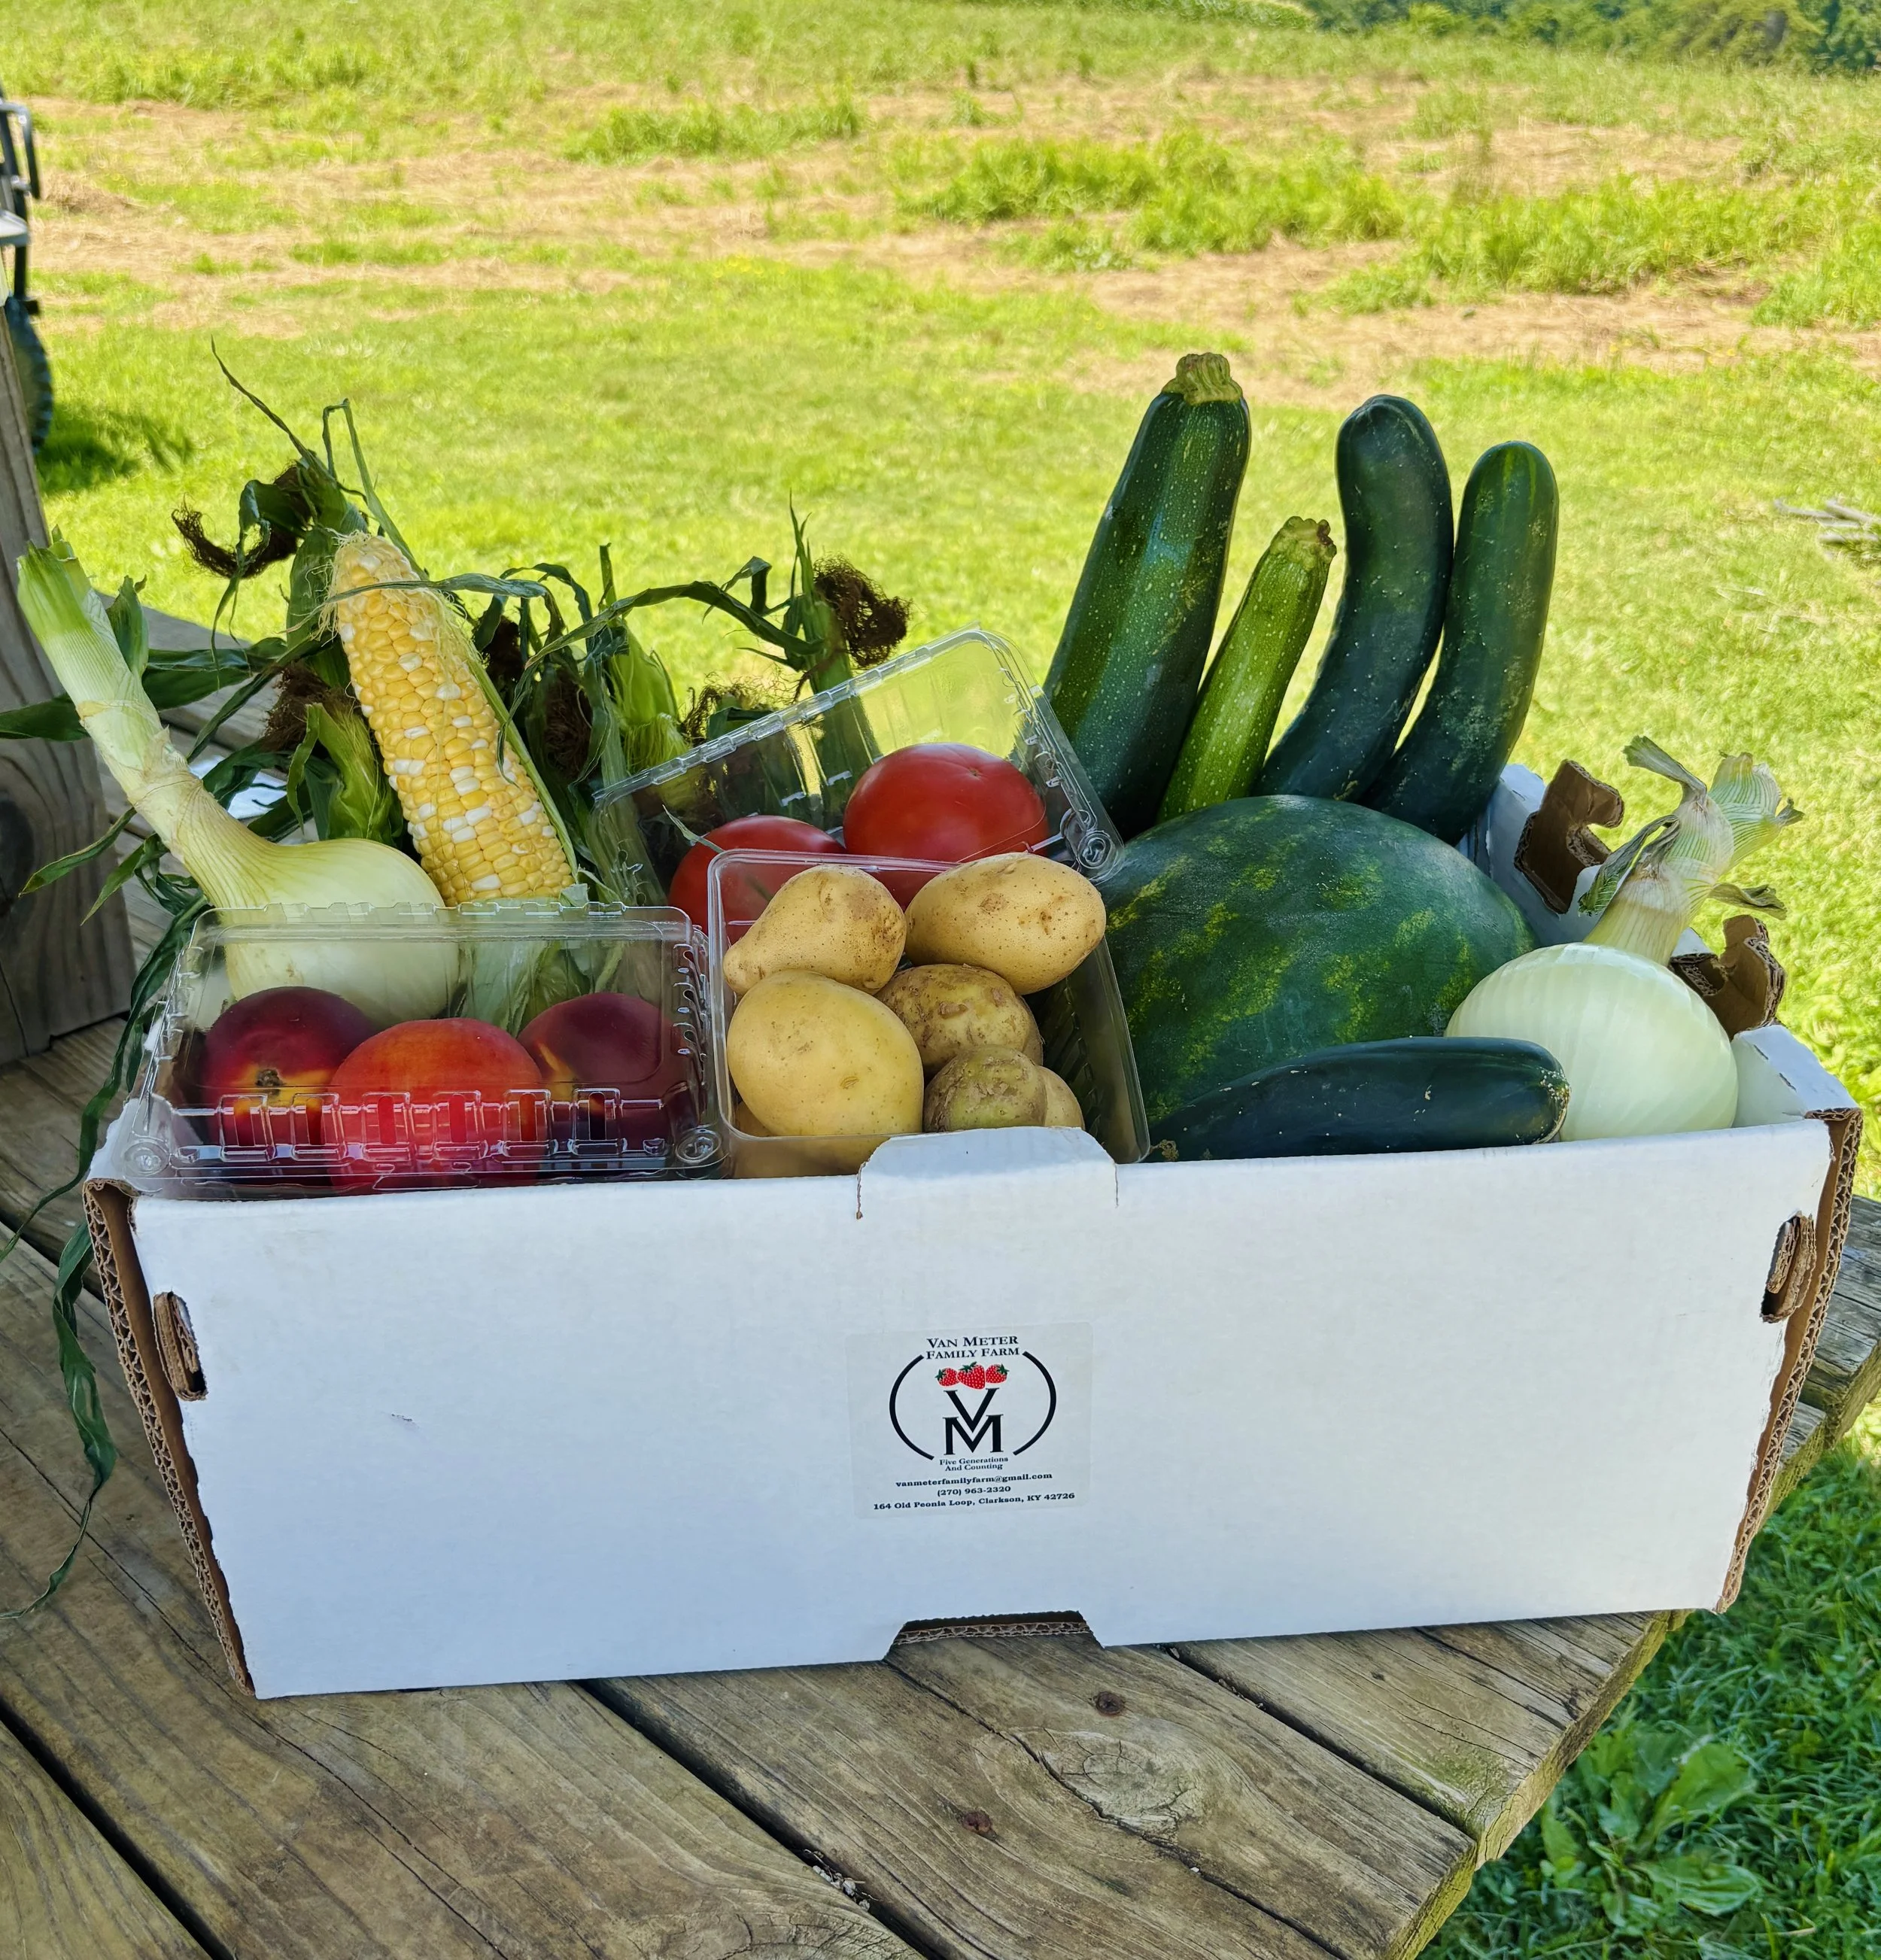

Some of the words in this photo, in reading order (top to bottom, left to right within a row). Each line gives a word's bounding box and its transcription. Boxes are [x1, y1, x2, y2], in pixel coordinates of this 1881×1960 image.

[926, 1338, 958, 1348] VAN
[963, 1336, 1020, 1347] METER
[925, 1349, 977, 1360] FAMILY
[981, 1347, 1020, 1357] FARM
[959, 1456, 1009, 1464] Generations
[964, 1463, 1004, 1471] Counting
[895, 1472, 1053, 1487] vanmeterfamilyfarm@gmail.com
[937, 1488, 962, 1497] (270)
[964, 1486, 1011, 1495] 963-2320
[874, 1502, 892, 1510] 164
[894, 1501, 911, 1509] Old
[913, 1500, 947, 1509] Peonia
[949, 1497, 975, 1507] Loop,
[978, 1494, 1024, 1505] Clarkson,
[1026, 1494, 1041, 1502] KY
[1044, 1492, 1075, 1501] 42726
